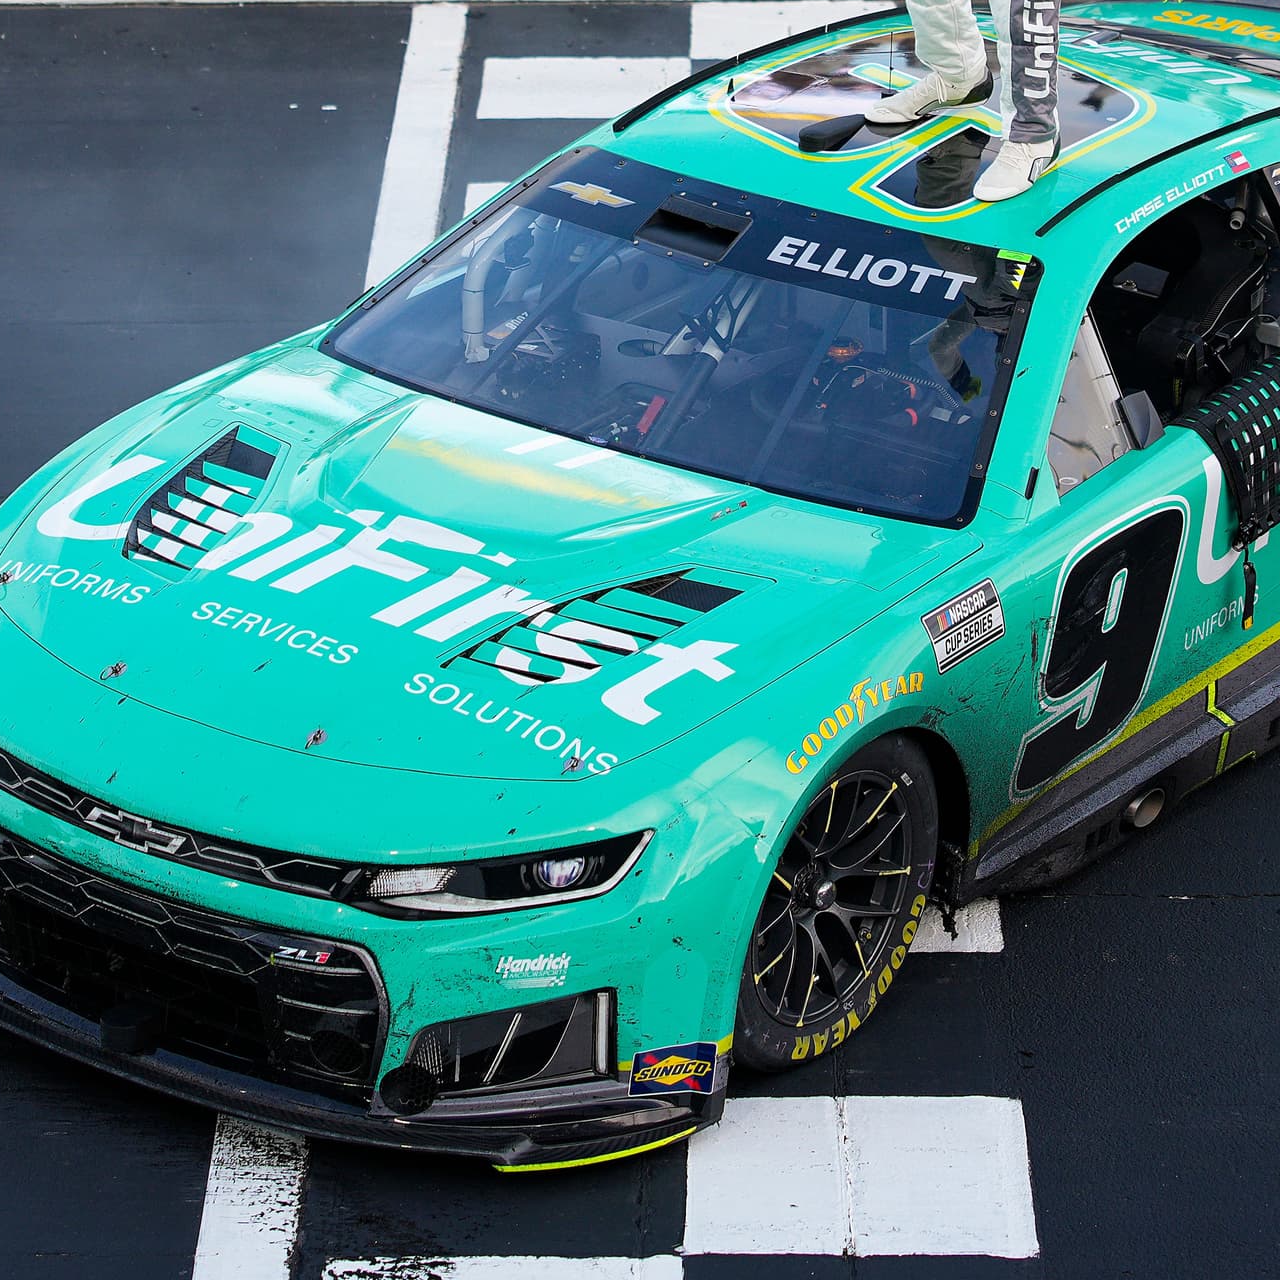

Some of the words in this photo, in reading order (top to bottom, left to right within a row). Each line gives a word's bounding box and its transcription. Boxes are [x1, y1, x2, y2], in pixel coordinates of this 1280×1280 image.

[1114, 194, 1165, 235] CHASE
[1166, 164, 1226, 207] ELLIOTT
[766, 235, 978, 302] ELLIOTT
[36, 454, 742, 727] UniFirst
[948, 589, 987, 625] NASCAR
[945, 631, 962, 655] CUP
[963, 613, 993, 644] SERIES
[1011, 496, 1190, 802] 9
[191, 600, 361, 666] SERVICES
[403, 671, 619, 777] SOLUTIONS
[786, 670, 925, 776] GOODYEAR
[496, 952, 572, 979] Hendrick
[791, 893, 927, 1061] GOODYEAR
[635, 1060, 712, 1082] SUNOCO
